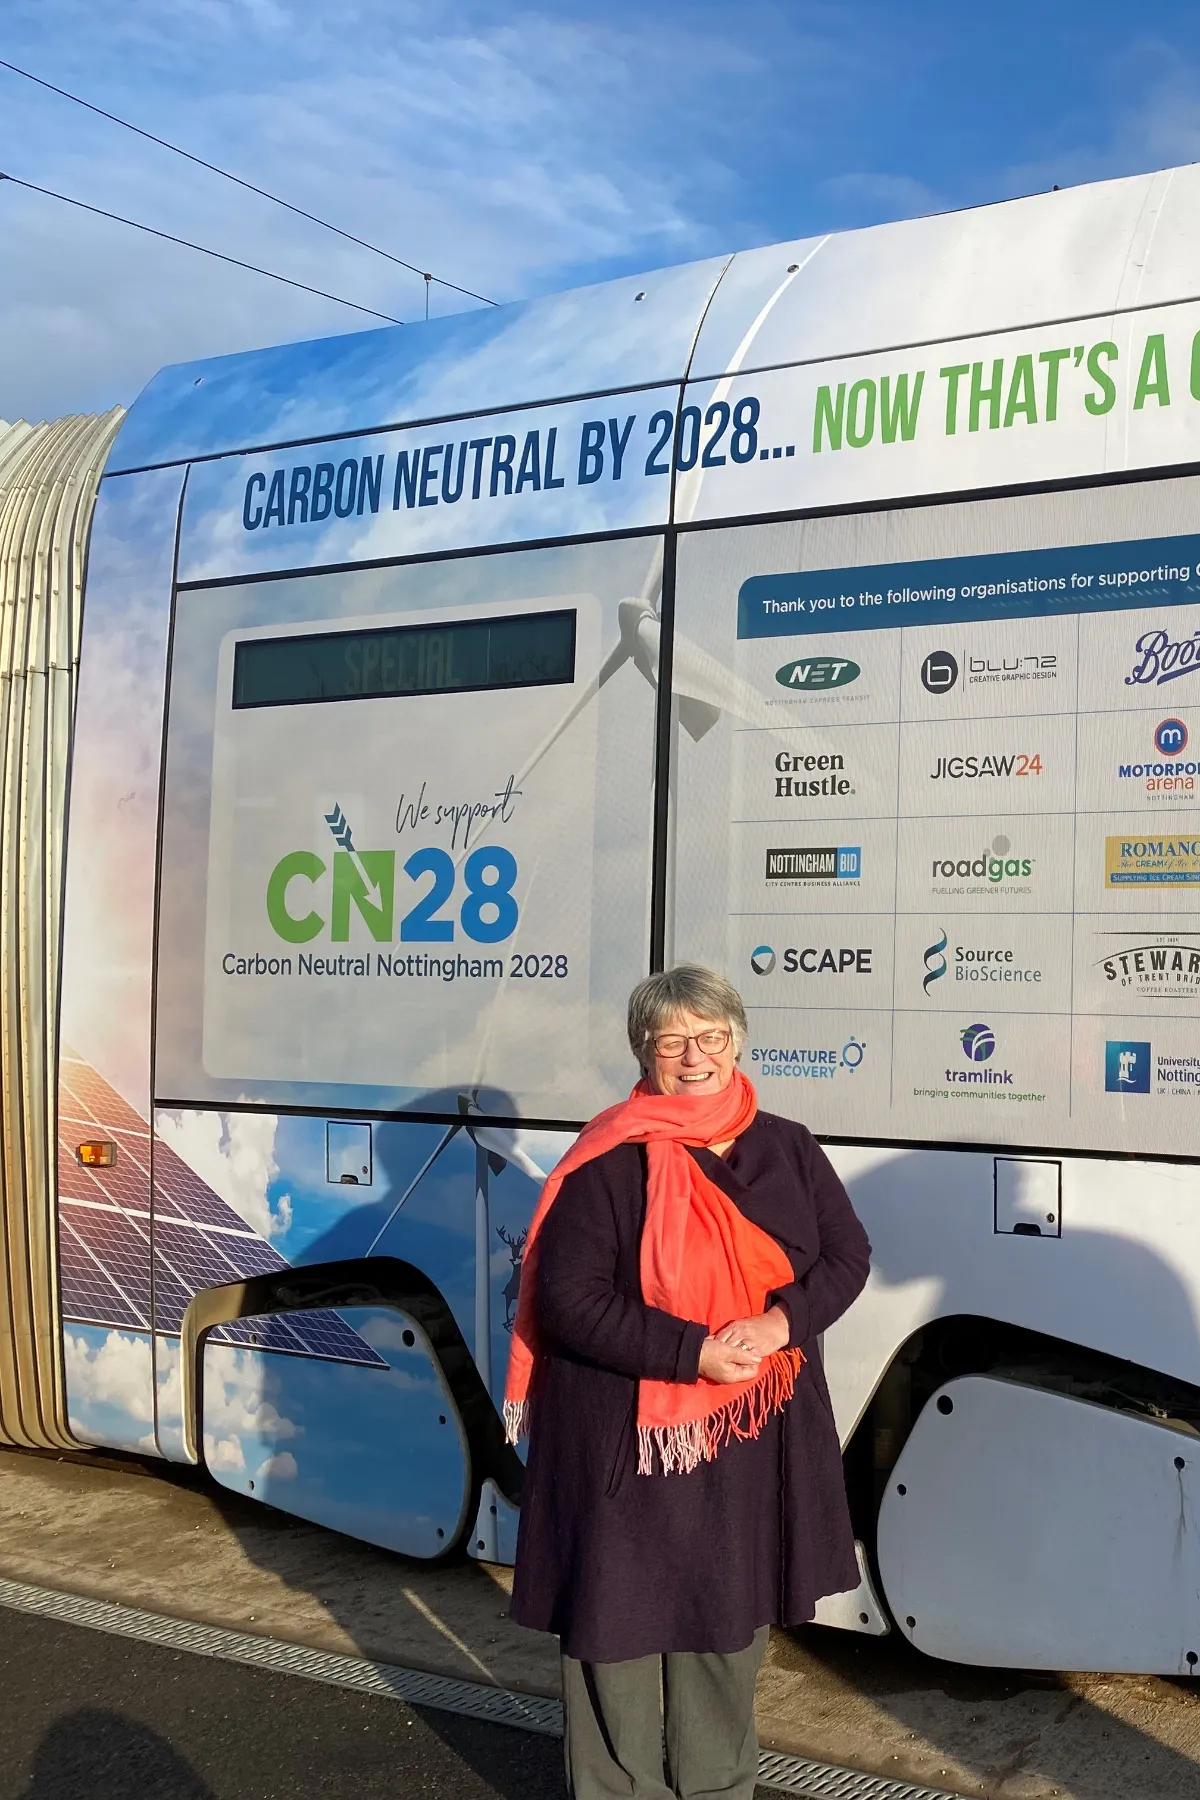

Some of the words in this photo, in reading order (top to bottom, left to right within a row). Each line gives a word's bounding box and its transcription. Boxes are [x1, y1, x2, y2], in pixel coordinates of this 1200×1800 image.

[242, 454, 385, 530] CARBON
[392, 426, 564, 510] NEUTRAL
[577, 415, 638, 484] BY
[644, 397, 795, 476] 2028...
[812, 371, 925, 453] NOW
[939, 341, 1119, 436] THAT'S
[1132, 333, 1171, 410] A
[763, 597, 806, 614] Thank
[809, 597, 836, 613] you
[839, 595, 855, 608] to
[859, 591, 883, 606] the
[887, 585, 956, 604] following
[960, 576, 1066, 599] organisations
[1071, 572, 1094, 589] for
[1098, 563, 1191, 587] supporting
[343, 632, 461, 692] SPECIAL
[788, 662, 848, 684] NET
[969, 674, 1000, 683] CREATIVE
[1002, 673, 1030, 681] GRAPHIC
[1032, 671, 1057, 680] DESIGN
[774, 751, 845, 772] Green
[929, 753, 1043, 780] JIGSAW24
[774, 774, 856, 797] Hustle.
[1146, 776, 1194, 791] arena
[396, 781, 431, 833] We
[433, 774, 523, 851] support
[769, 853, 836, 874] NOTTINGHAM
[839, 852, 857, 873] BID
[932, 853, 1033, 882] roadgas
[1136, 860, 1163, 868] CREAM
[266, 845, 519, 944] CN28
[783, 948, 872, 974] SCAPE
[955, 946, 1013, 963] Source
[222, 952, 292, 976] Carbon
[299, 953, 370, 977] Neutral
[377, 952, 503, 981] Nottingham
[510, 955, 568, 979] 2028
[955, 966, 1042, 982] BioScience
[1121, 977, 1133, 987] OF
[1138, 972, 1169, 982] TRENT
[751, 1048, 837, 1064] SYGNATURE
[761, 1063, 837, 1079] DISCOVERY
[945, 1068, 1014, 1085] tramlink
[913, 1087, 949, 1098] bringing
[950, 1089, 1006, 1100] communities
[1008, 1092, 1046, 1102] together
[1171, 1088, 1191, 1096] CHINA
